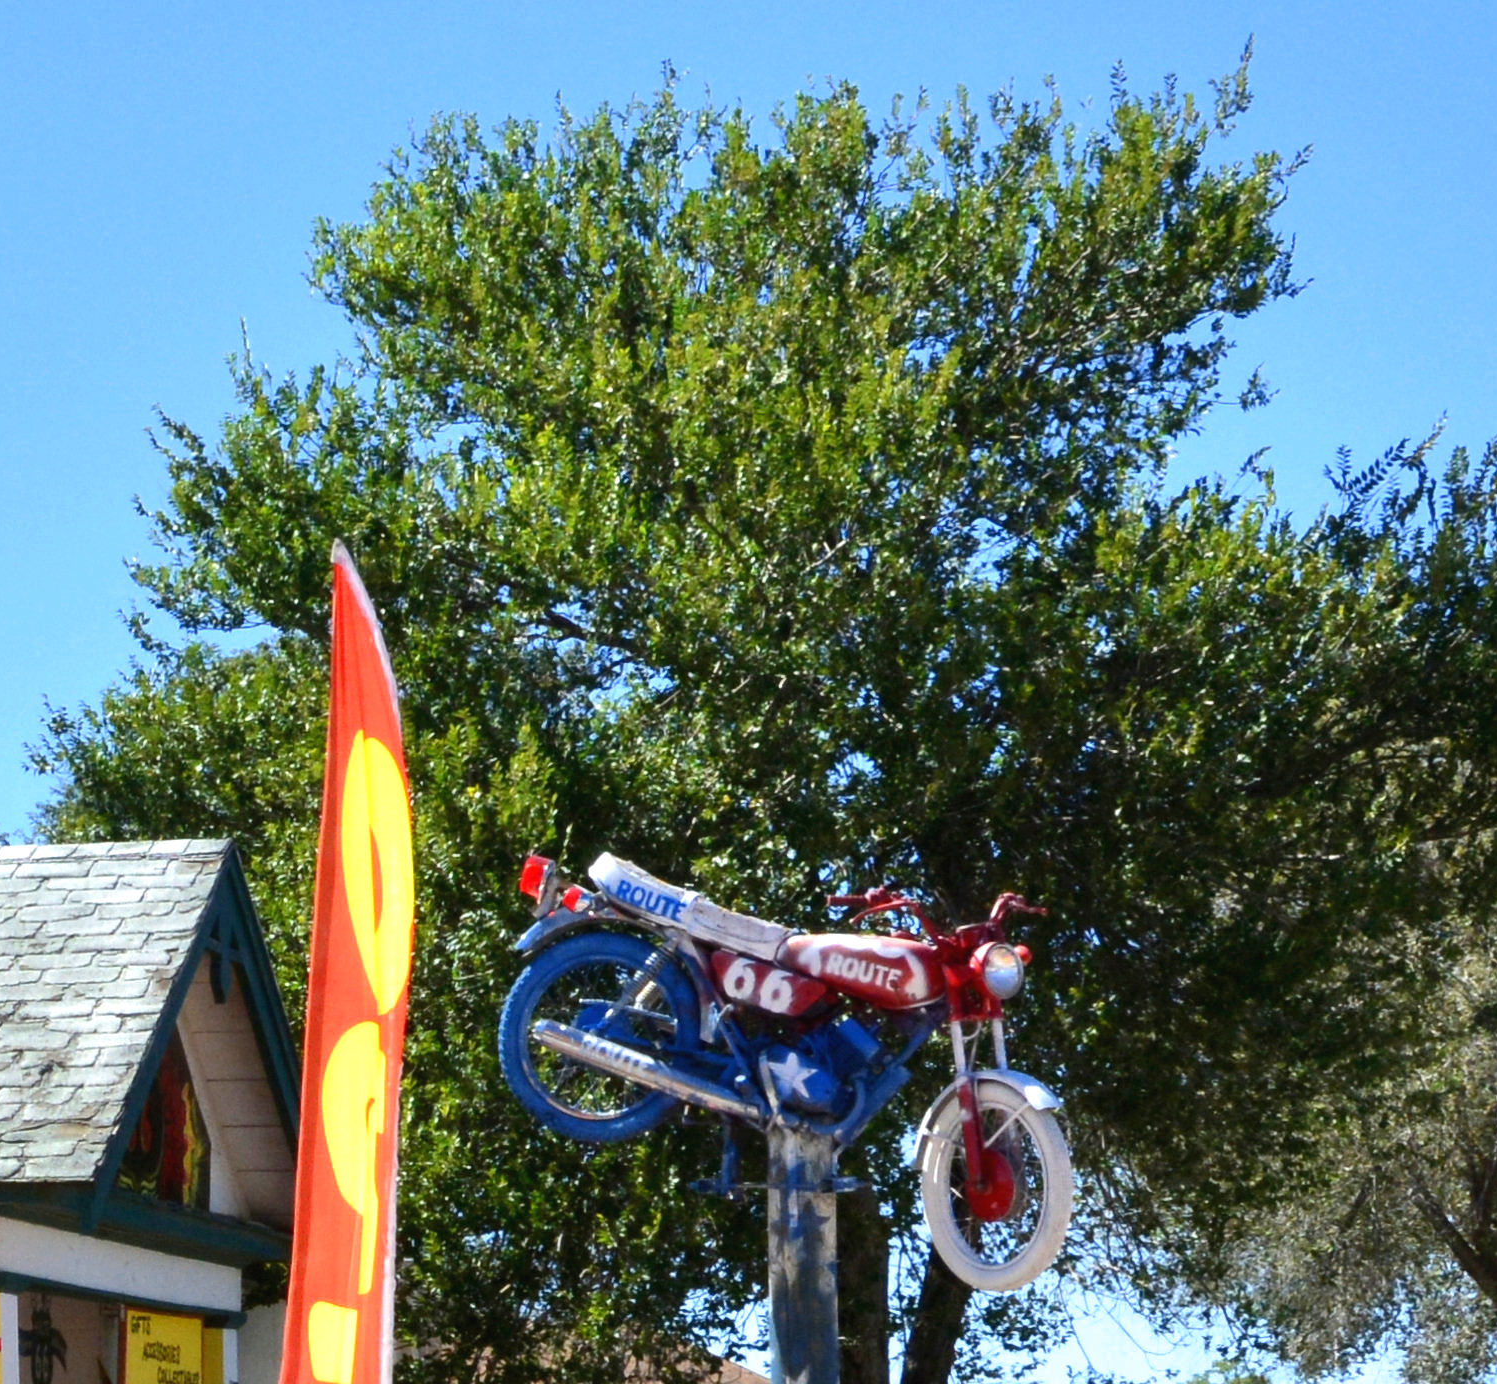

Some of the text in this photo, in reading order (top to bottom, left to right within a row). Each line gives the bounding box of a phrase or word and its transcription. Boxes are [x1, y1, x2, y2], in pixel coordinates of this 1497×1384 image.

[616, 878, 687, 920] ROUTE
[722, 958, 794, 1015] 66
[826, 952, 903, 992] ROUTE
